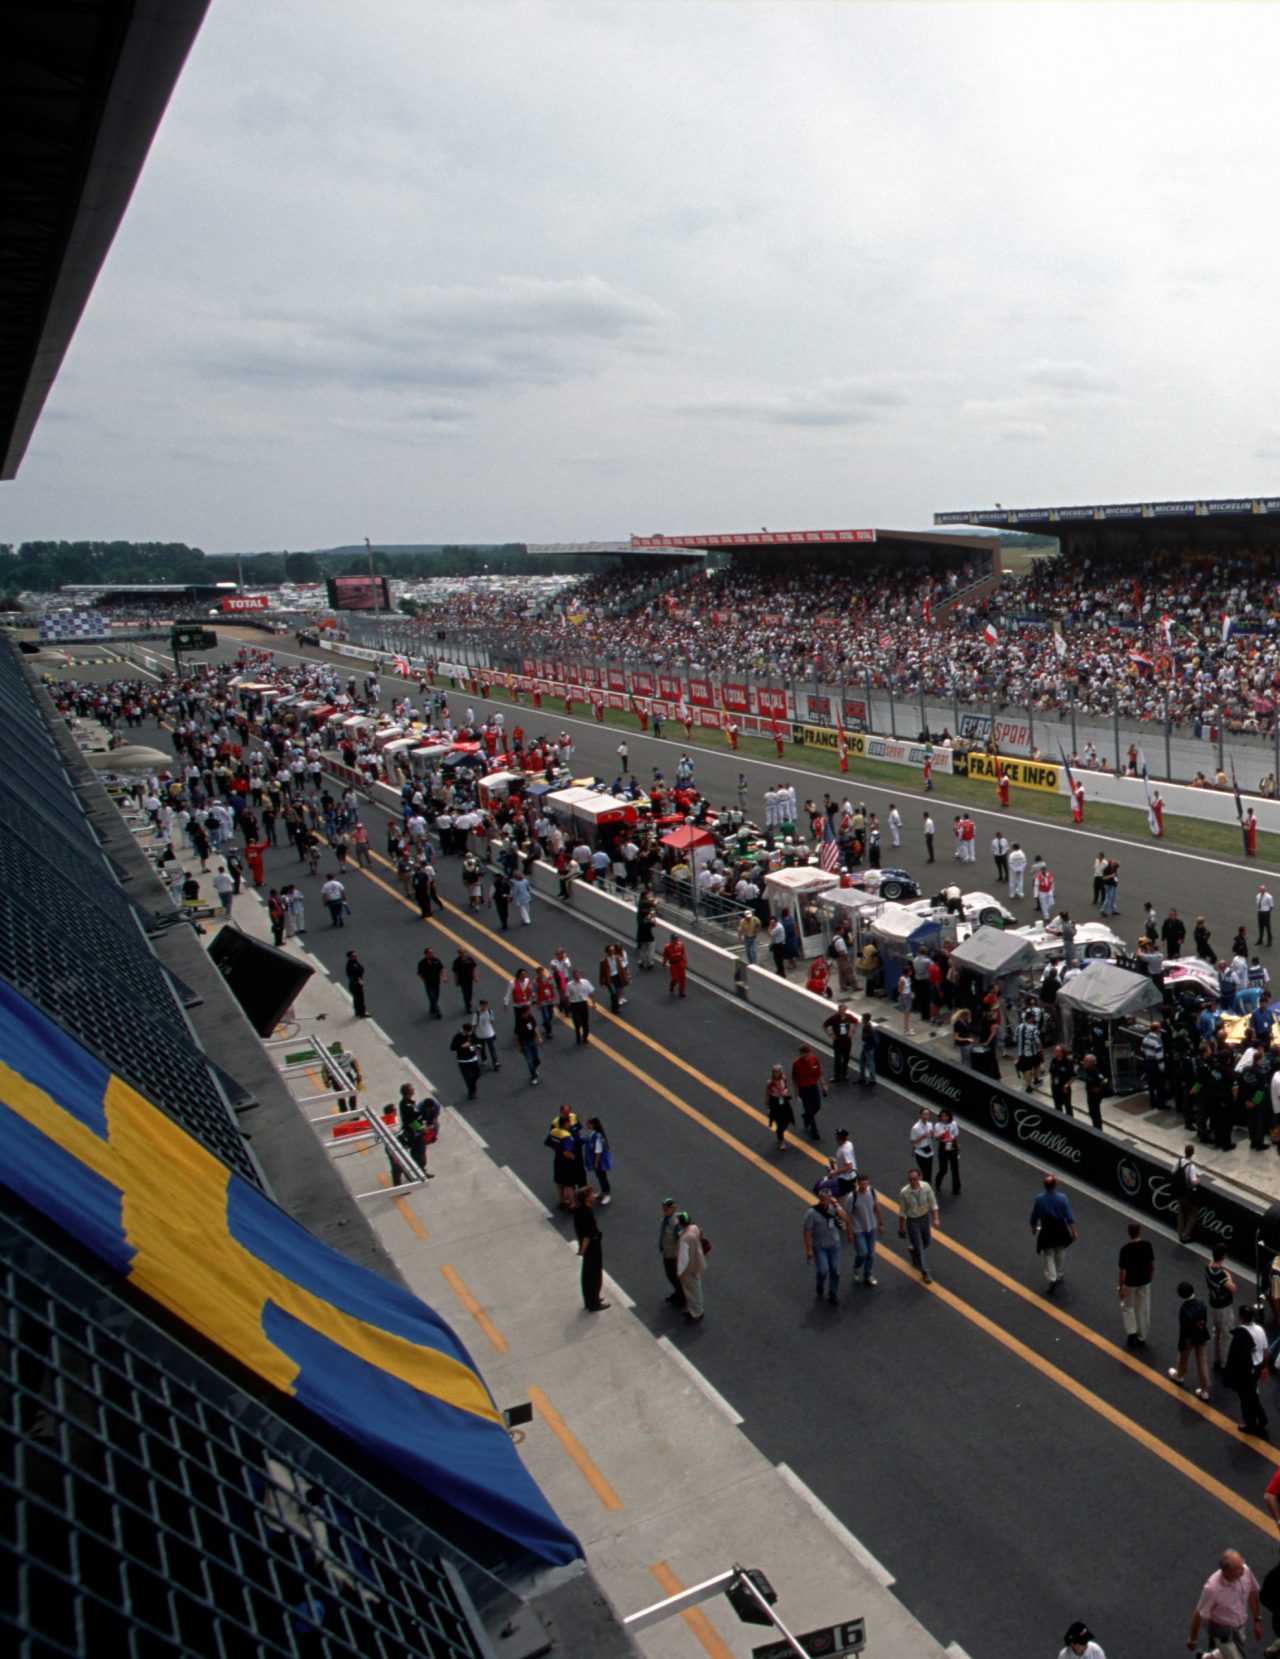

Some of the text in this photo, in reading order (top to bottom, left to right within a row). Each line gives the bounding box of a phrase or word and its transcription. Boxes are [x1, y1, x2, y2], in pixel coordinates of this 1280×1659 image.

[1059, 507, 1094, 518] MICHELIN
[1104, 505, 1142, 516] MICHELIN
[1154, 503, 1195, 513] MICHELIN
[1208, 501, 1251, 511] MICHELIN
[228, 598, 264, 609] TOTAL
[759, 692, 785, 710] TOTAL
[701, 711, 720, 726] TOTAL
[805, 729, 864, 753] FRANCE NFO
[1023, 765, 1057, 788] INFO
[907, 1055, 961, 1101] Cadillac
[1014, 1108, 1081, 1163] Cadillac
